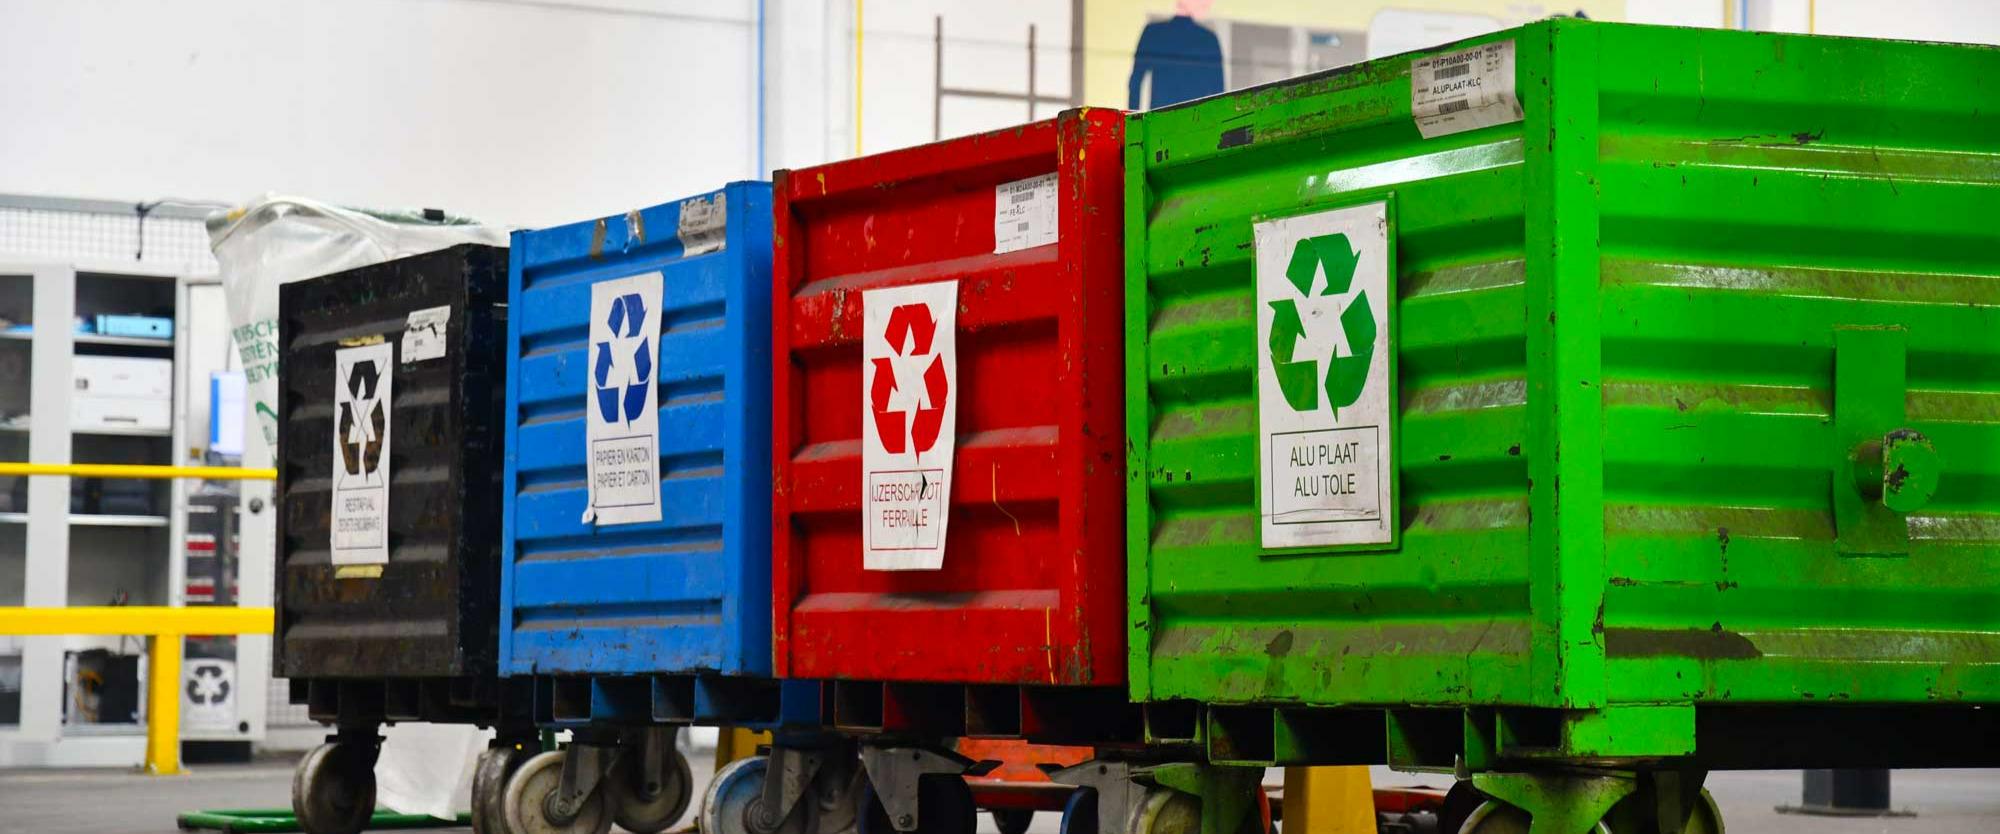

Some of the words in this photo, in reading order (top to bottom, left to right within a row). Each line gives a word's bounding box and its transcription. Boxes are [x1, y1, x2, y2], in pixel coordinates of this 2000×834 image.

[1432, 77, 1481, 95] ALUPLAAT-KLC
[596, 449, 616, 466] PAPIER
[617, 449, 625, 466] EN
[626, 447, 649, 464] KARTON
[1290, 446, 1315, 467] ALU
[1319, 442, 1359, 465] PLAAT
[597, 471, 617, 488] PAPIER
[618, 471, 625, 487] ET
[627, 470, 649, 486] CARTON
[1294, 476, 1319, 497] ALU
[1322, 473, 1356, 496] TOLE
